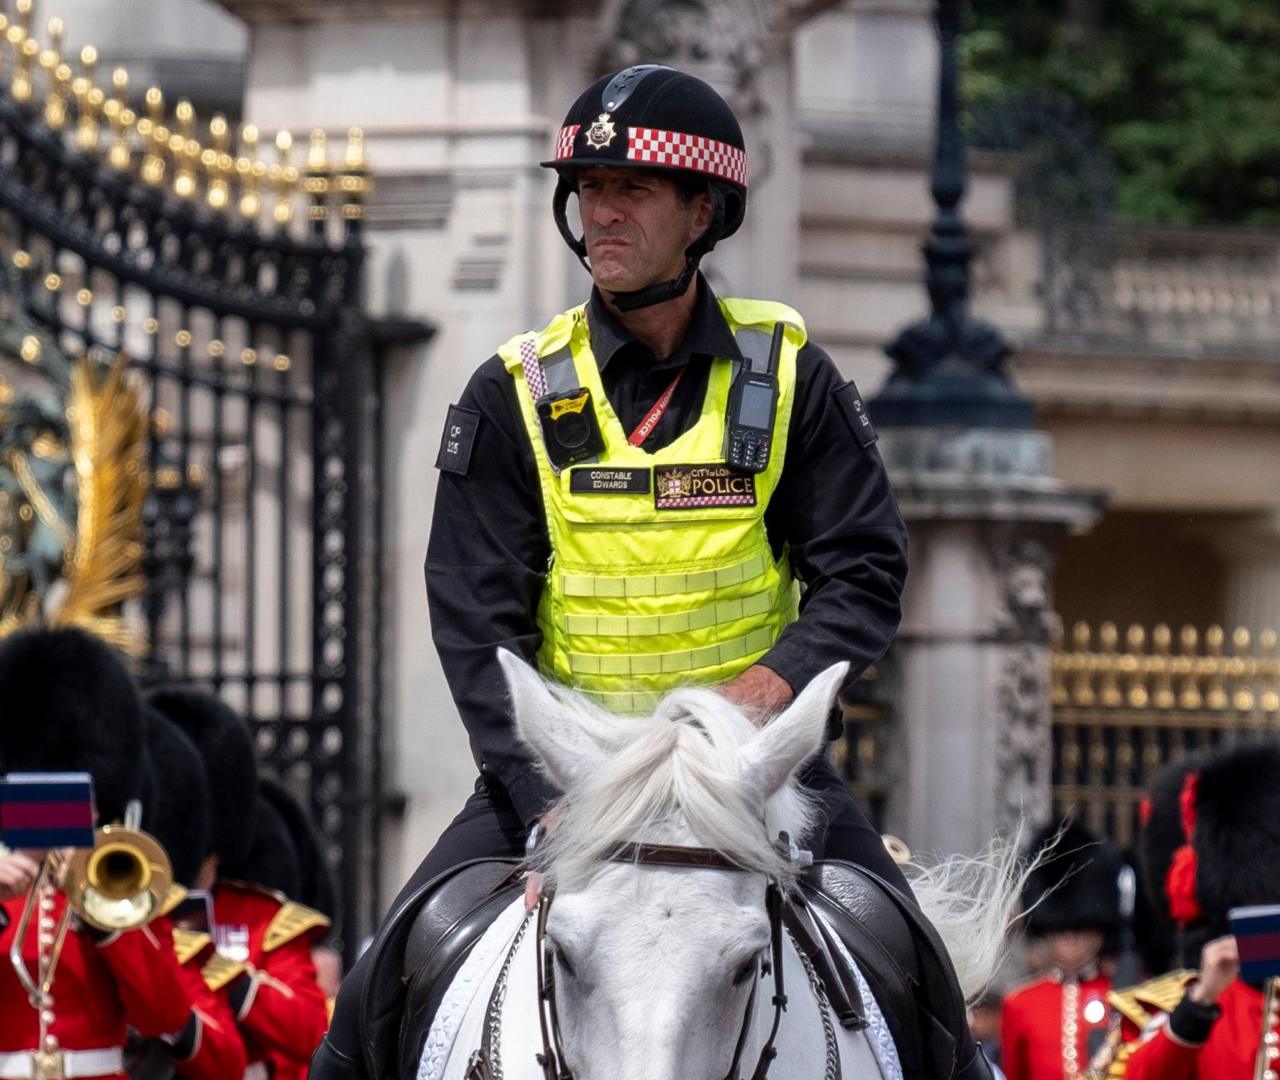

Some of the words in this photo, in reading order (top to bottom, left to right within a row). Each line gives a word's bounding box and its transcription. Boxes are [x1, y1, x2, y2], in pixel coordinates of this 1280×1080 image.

[638, 408, 662, 437] POLICE
[590, 471, 632, 480] CONSTABLE
[690, 468, 710, 477] CITY
[593, 480, 628, 489] EDWARDS
[692, 478, 753, 495] POLICE
